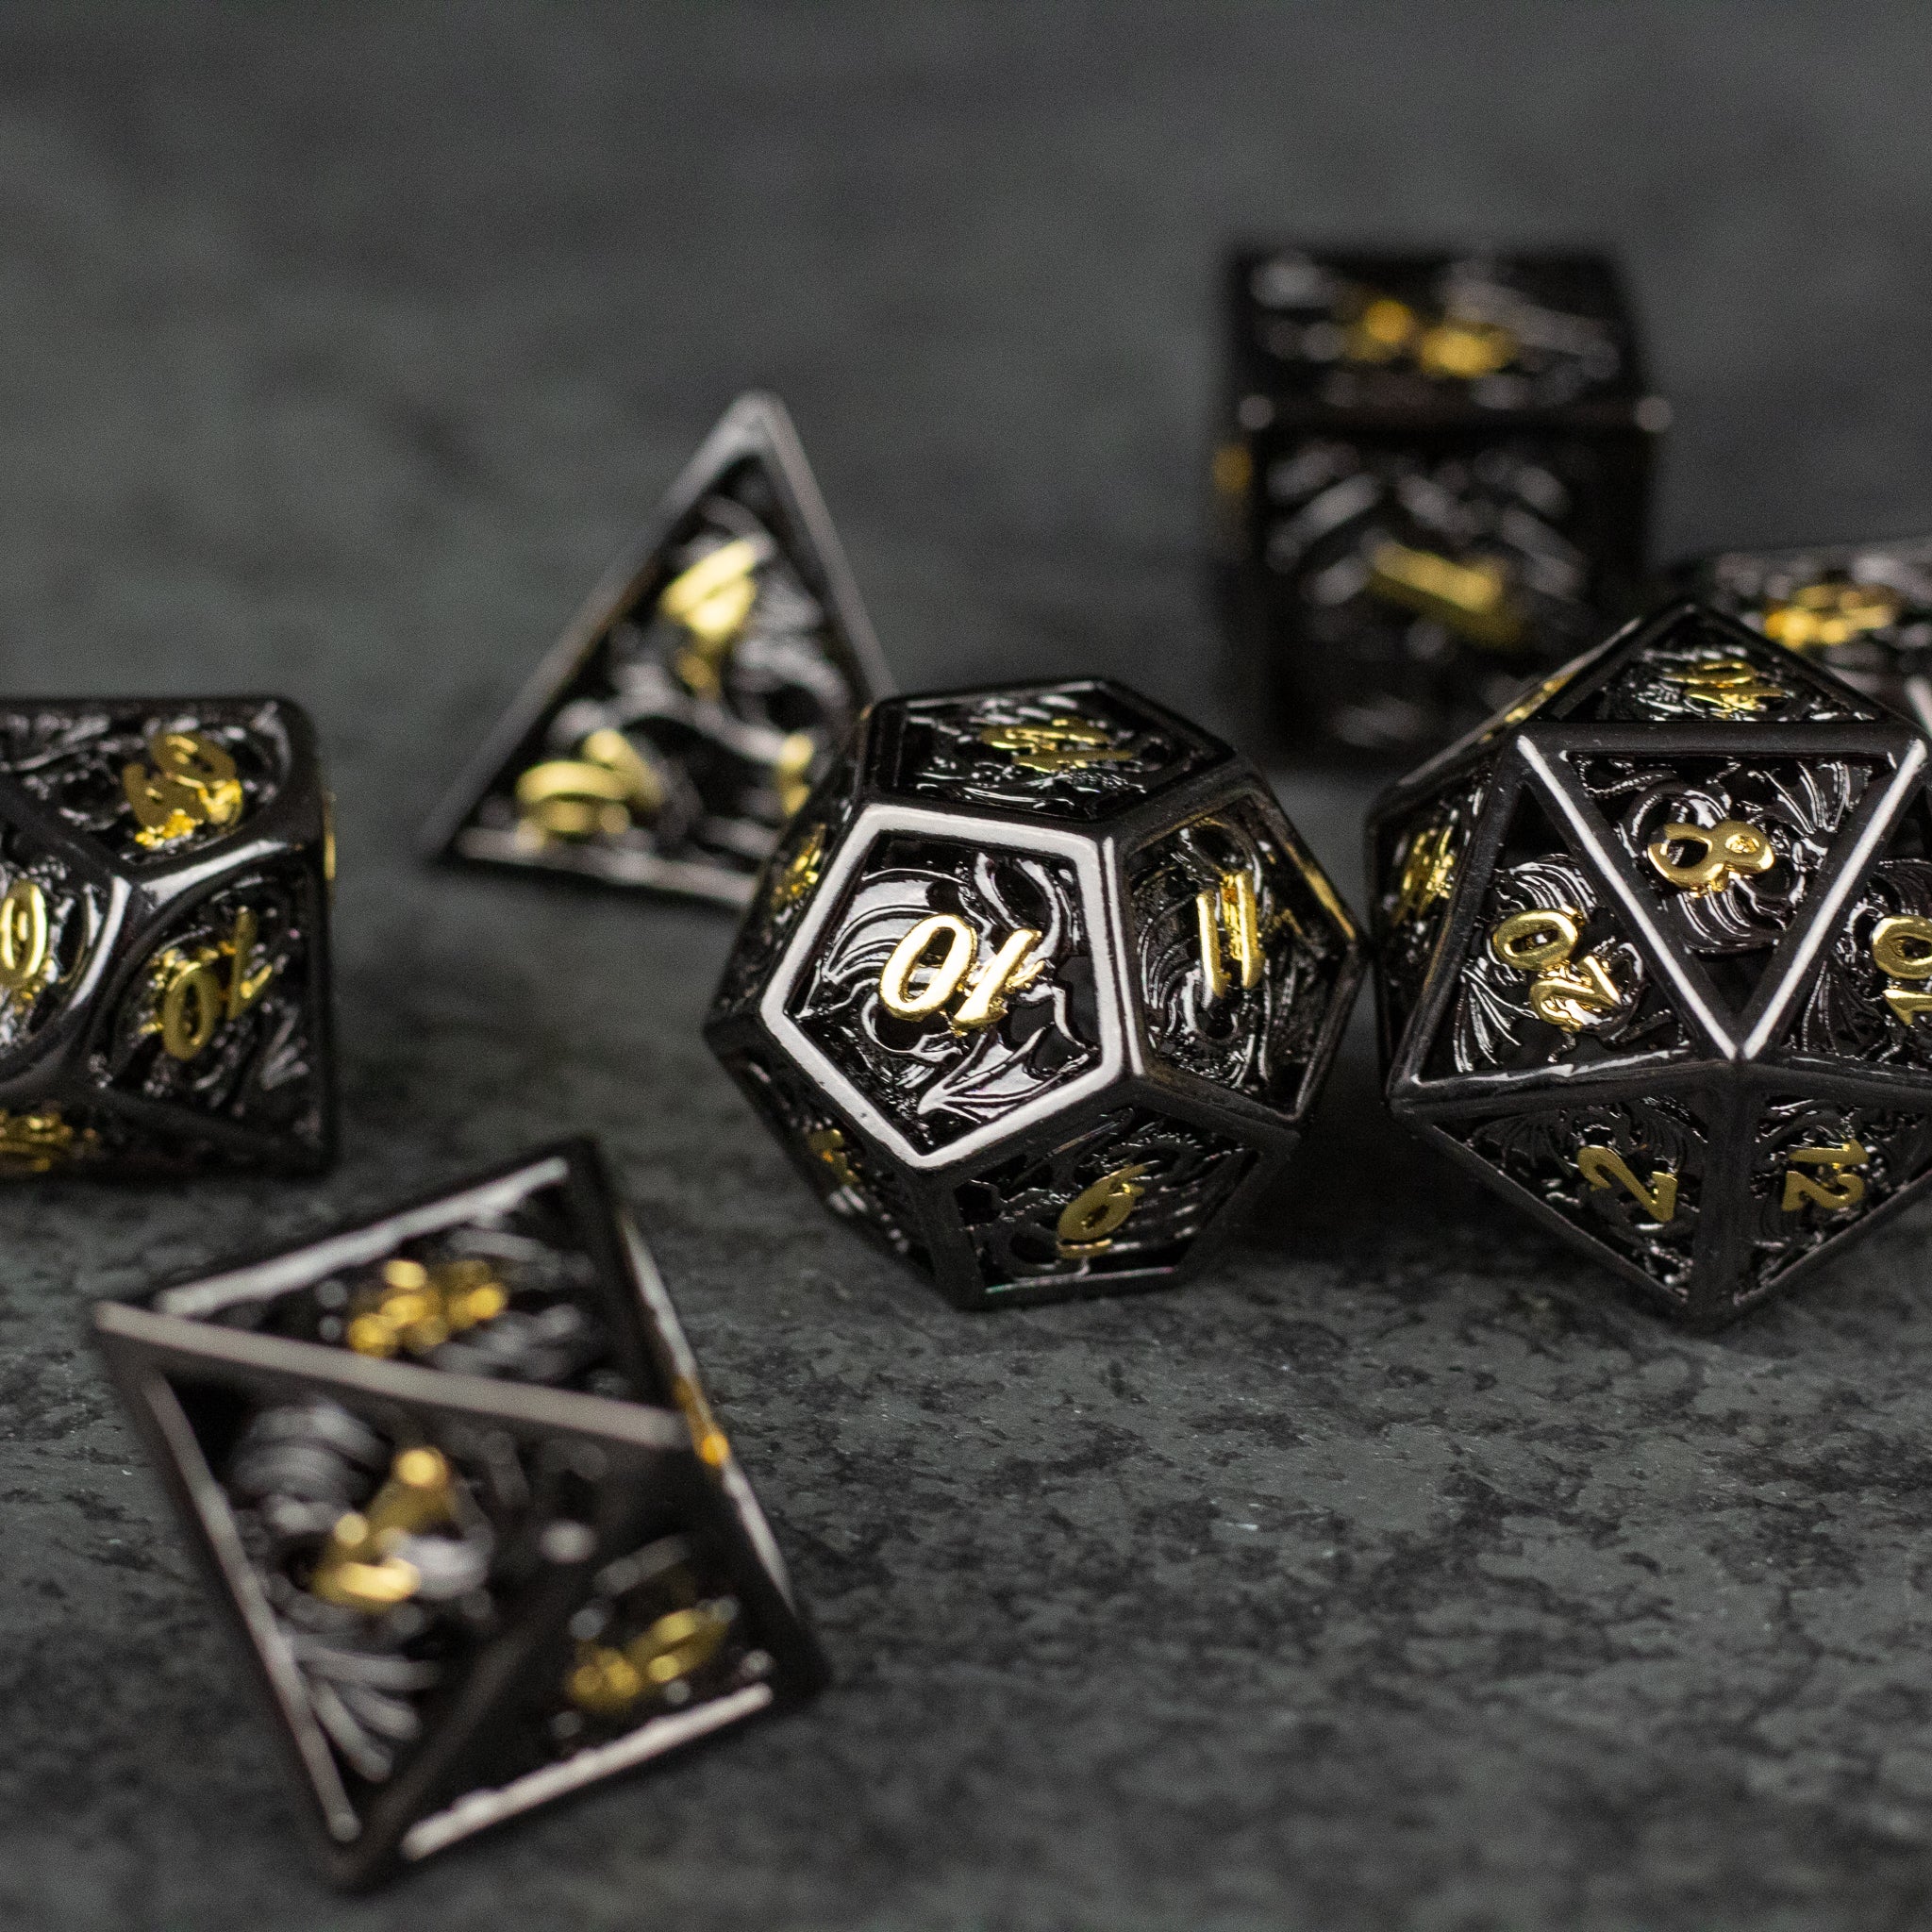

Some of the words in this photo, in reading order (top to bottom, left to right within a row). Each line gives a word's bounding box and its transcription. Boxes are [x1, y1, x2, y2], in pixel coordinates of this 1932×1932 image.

[1648, 819, 1775, 891] 8
[880, 913, 1042, 1029] 10
[1196, 869, 1266, 998] 11
[1493, 908, 1622, 1030] 20
[1577, 1144, 1678, 1222] 2
[1781, 1139, 1870, 1211] 12
